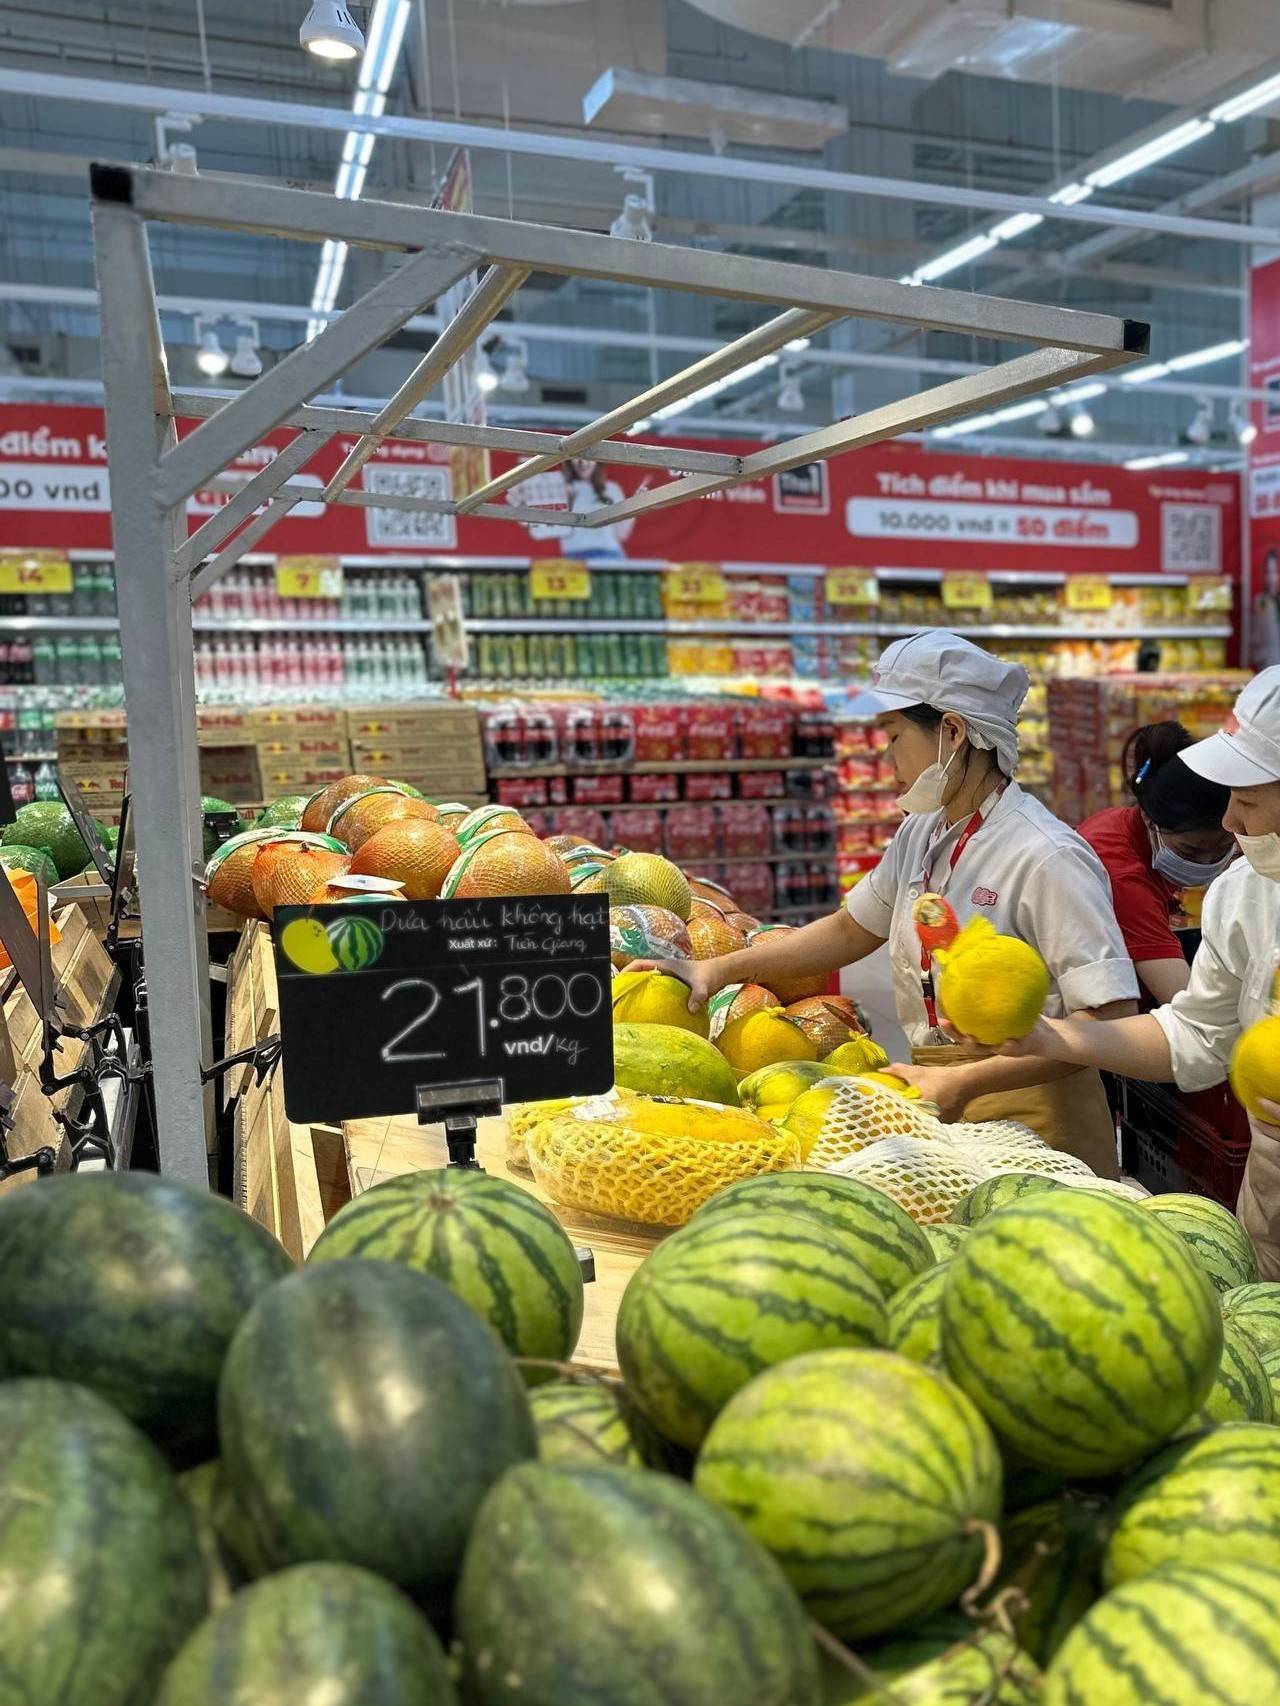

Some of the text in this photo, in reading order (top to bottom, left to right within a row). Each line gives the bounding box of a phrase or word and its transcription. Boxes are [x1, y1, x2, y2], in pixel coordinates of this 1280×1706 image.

[43, 479, 100, 501] vnd
[501, 904, 562, 935] không
[449, 938, 474, 950] Xuất
[381, 972, 603, 1062] 21.800
